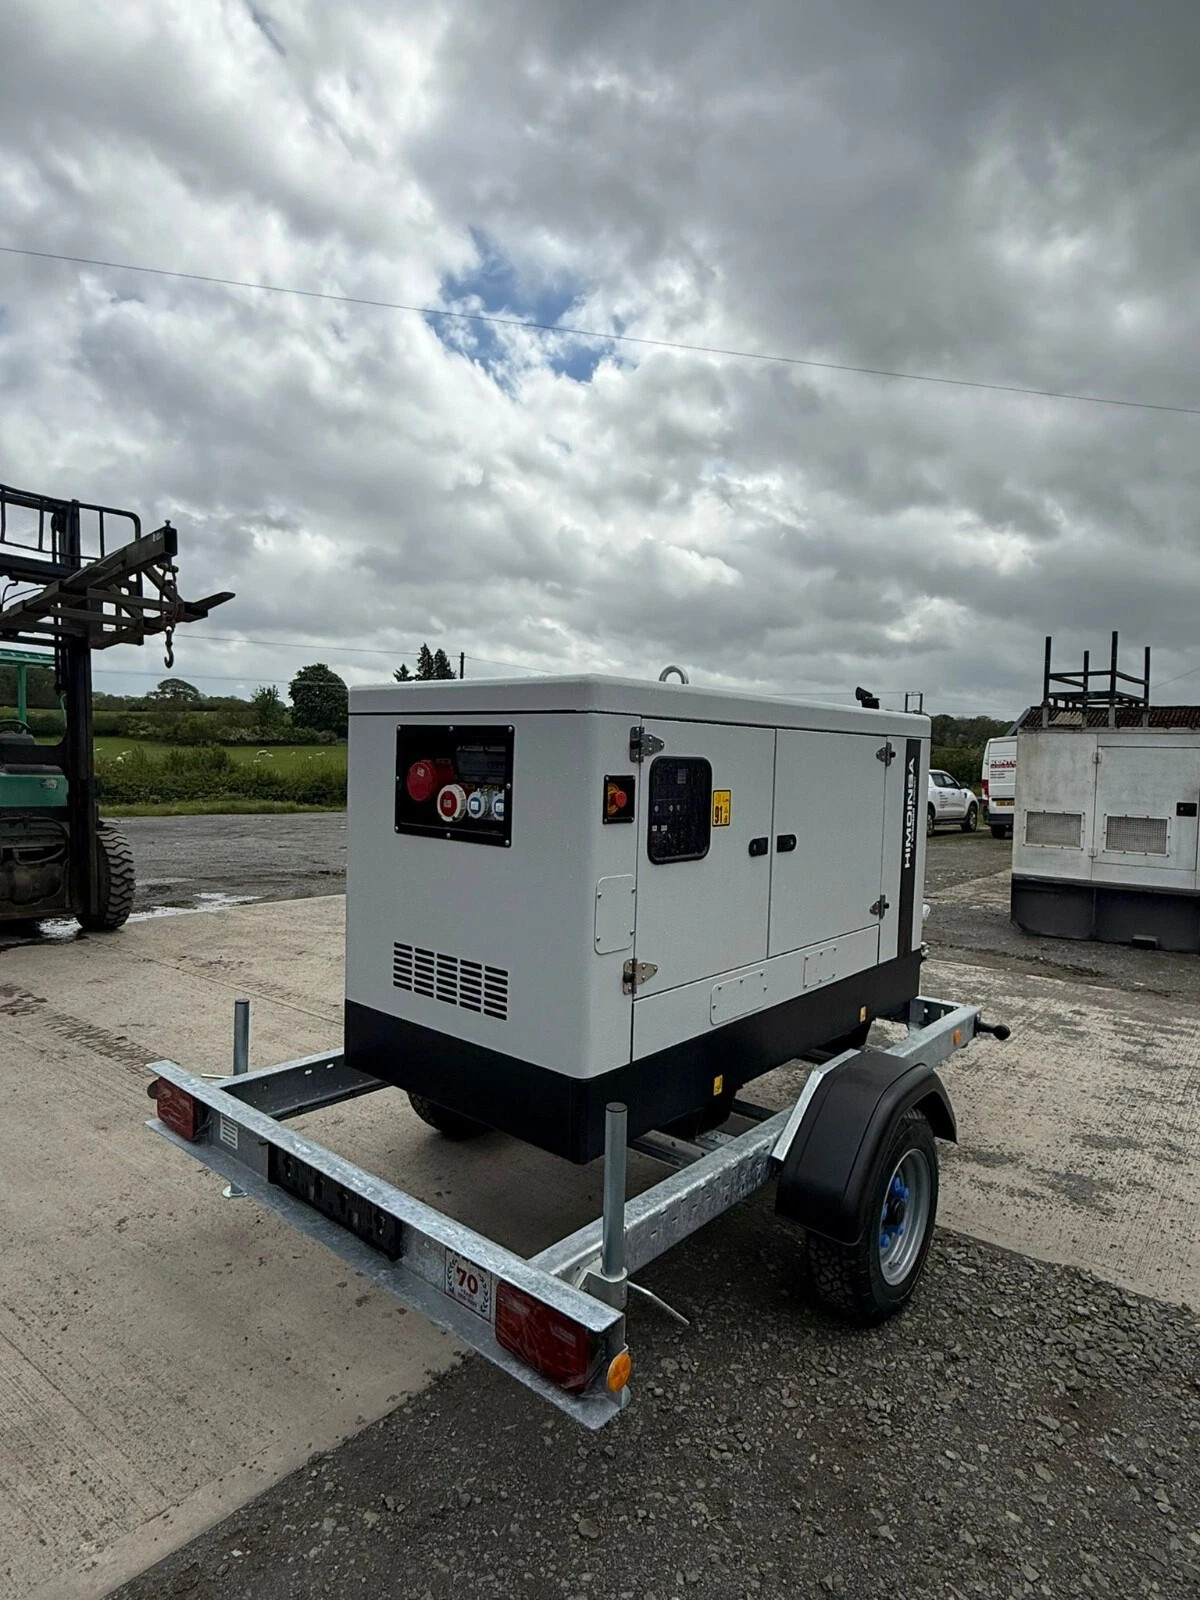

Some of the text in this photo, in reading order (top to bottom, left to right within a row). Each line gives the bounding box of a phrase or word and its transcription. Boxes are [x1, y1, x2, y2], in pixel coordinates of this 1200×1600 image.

[715, 806, 722, 824] 91
[904, 758, 914, 868] HIMOINSA
[456, 1266, 478, 1294] 70
